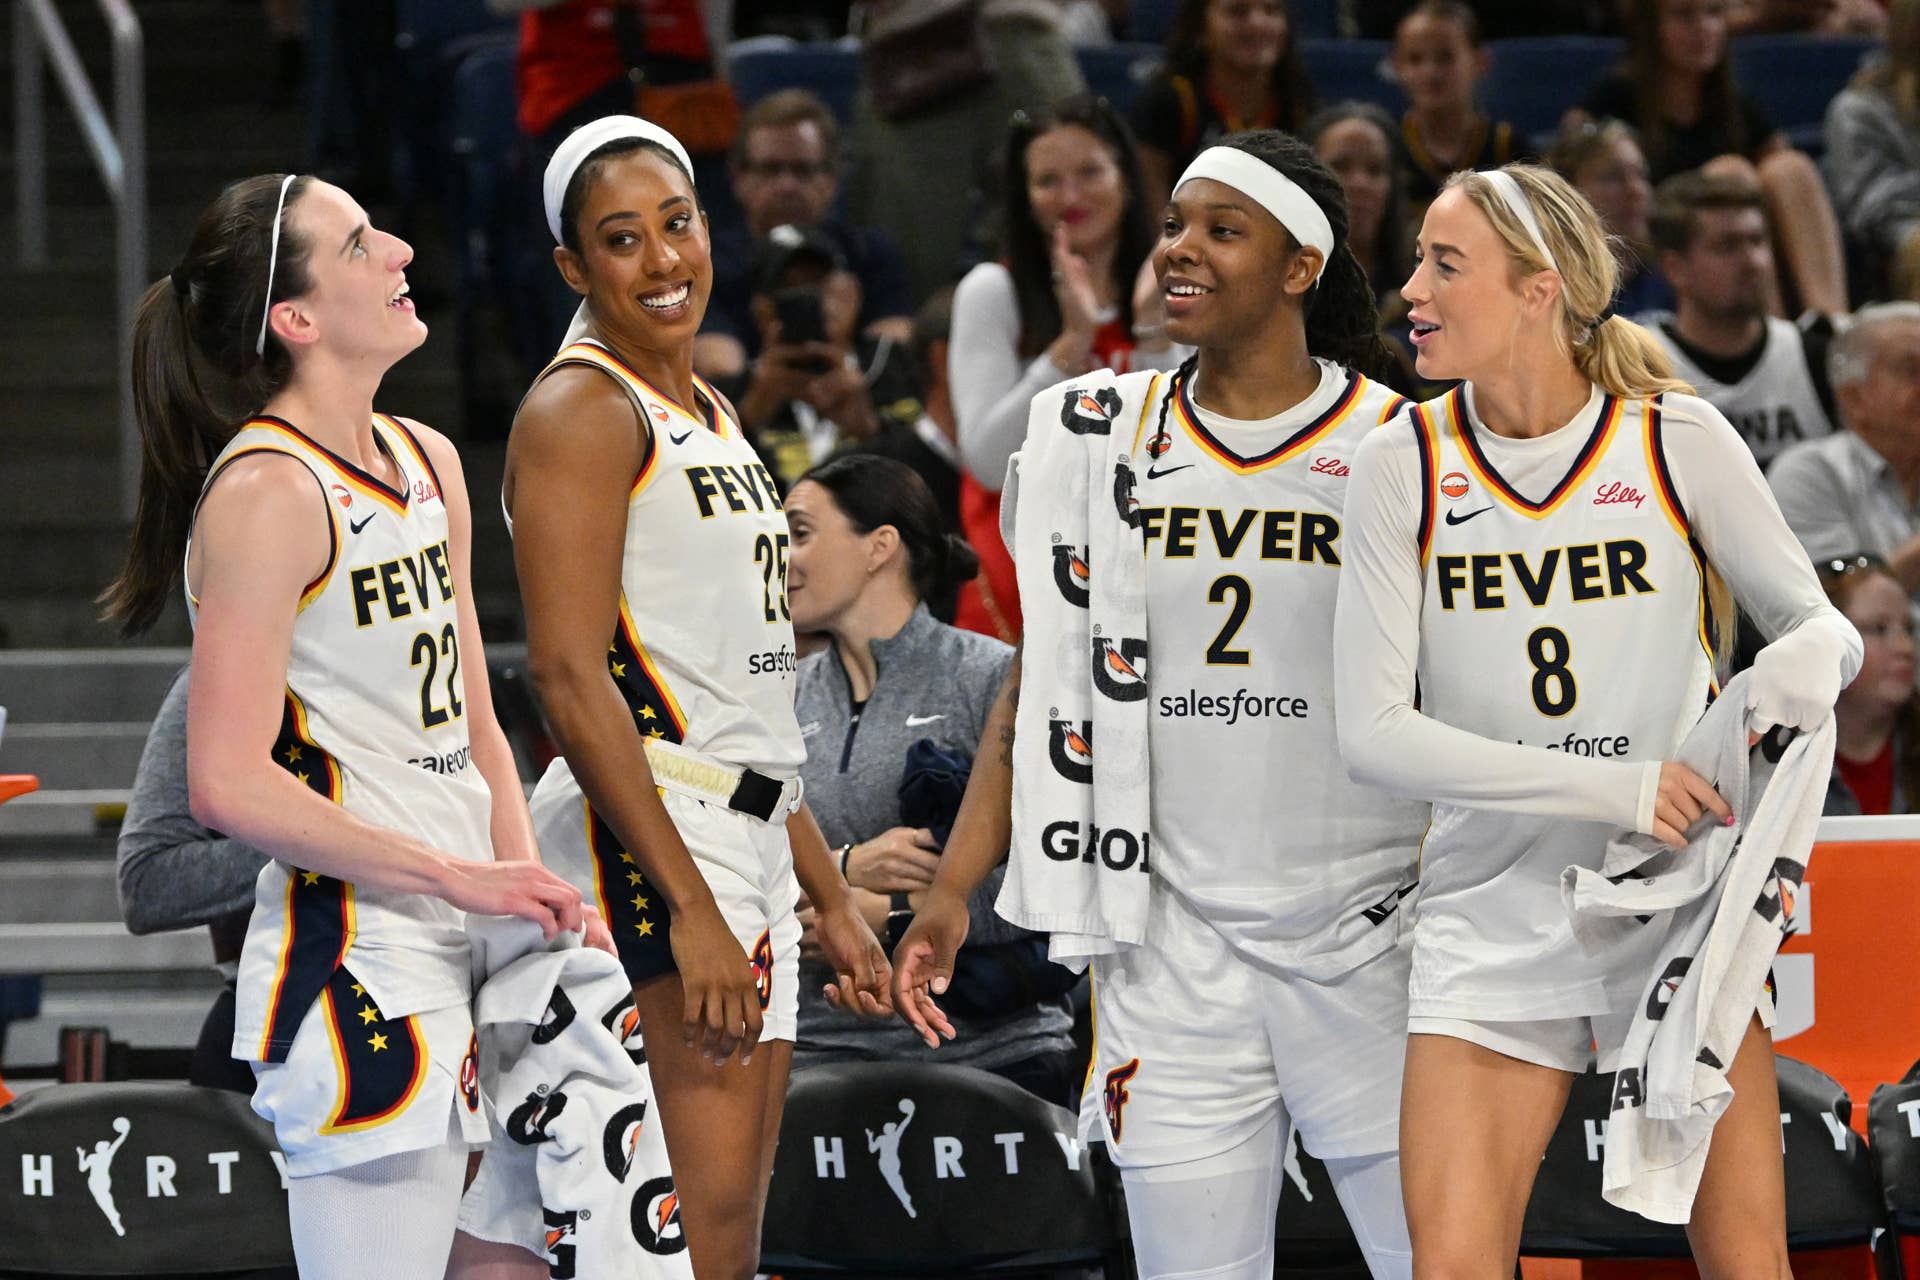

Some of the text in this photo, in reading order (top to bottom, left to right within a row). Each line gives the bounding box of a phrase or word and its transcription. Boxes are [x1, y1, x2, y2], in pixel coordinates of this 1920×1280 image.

[683, 463, 785, 520] FEVE
[1310, 457, 1349, 477] Lill
[1593, 481, 1647, 509] Lilly
[1139, 505, 1342, 567] FEVER
[350, 538, 456, 628] FEVE
[754, 532, 791, 625] 25
[1436, 539, 1659, 612] FEVER
[1204, 573, 1252, 667] 2
[409, 622, 463, 731] 22
[1159, 689, 1308, 725] salesforce
[1526, 625, 1578, 719] 8
